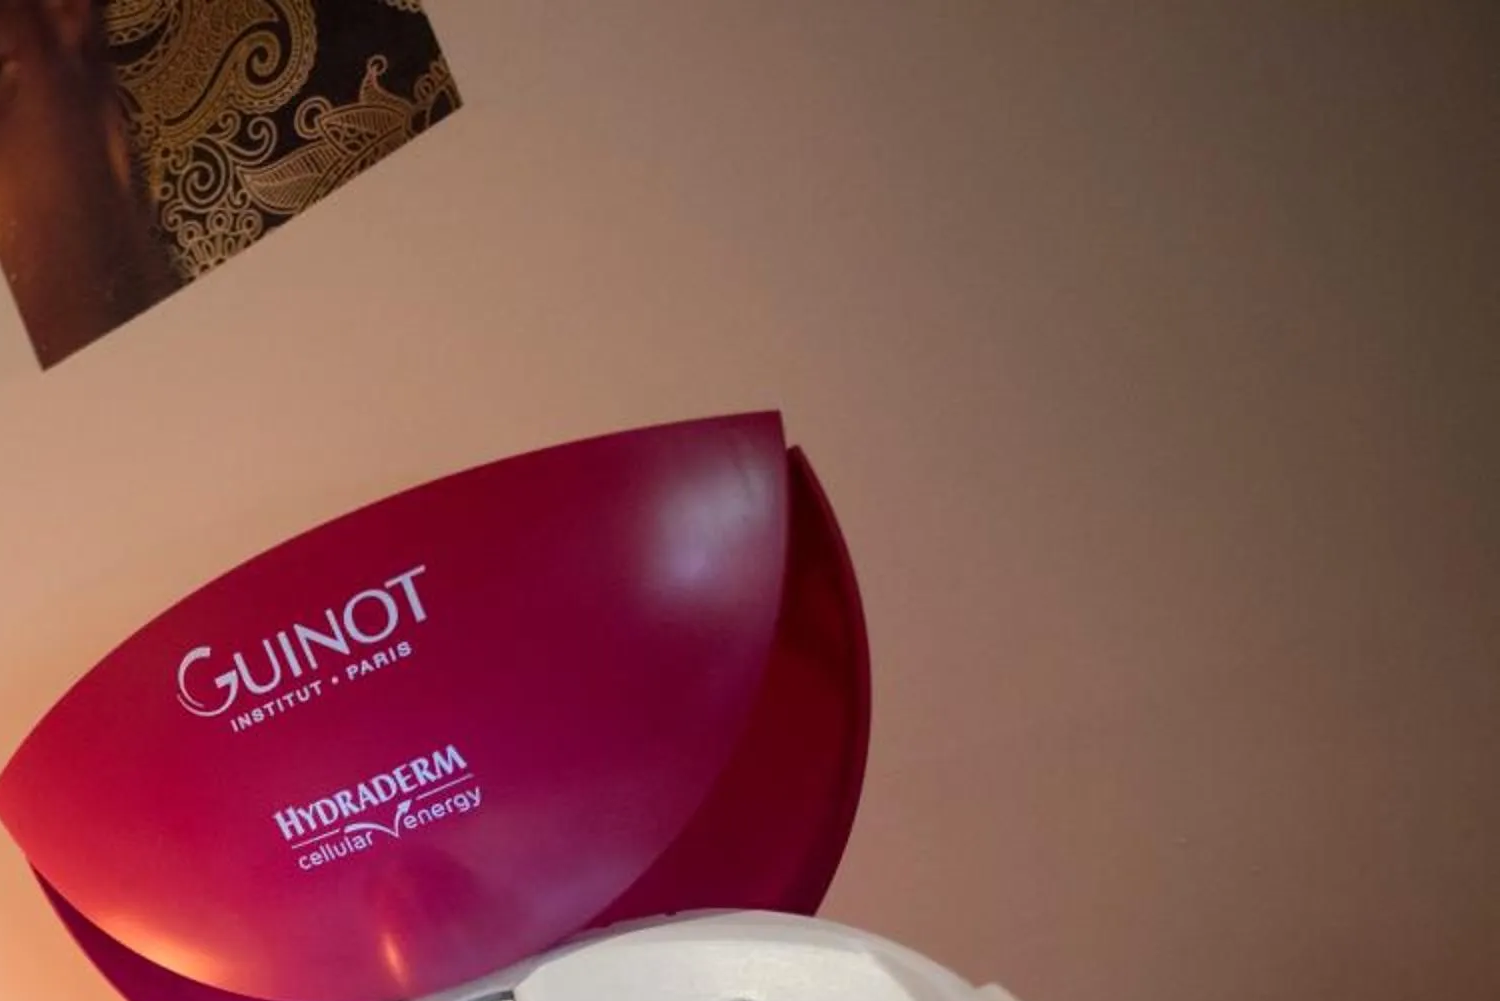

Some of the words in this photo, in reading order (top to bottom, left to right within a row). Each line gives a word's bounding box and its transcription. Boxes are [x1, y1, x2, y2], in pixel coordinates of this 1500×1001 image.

[177, 564, 427, 717] GUINOT
[230, 679, 323, 732] INSTITUT
[346, 640, 412, 680] PARIS
[272, 744, 468, 841] HYDRADERM
[298, 830, 375, 871] cellular
[403, 786, 482, 830] energy
